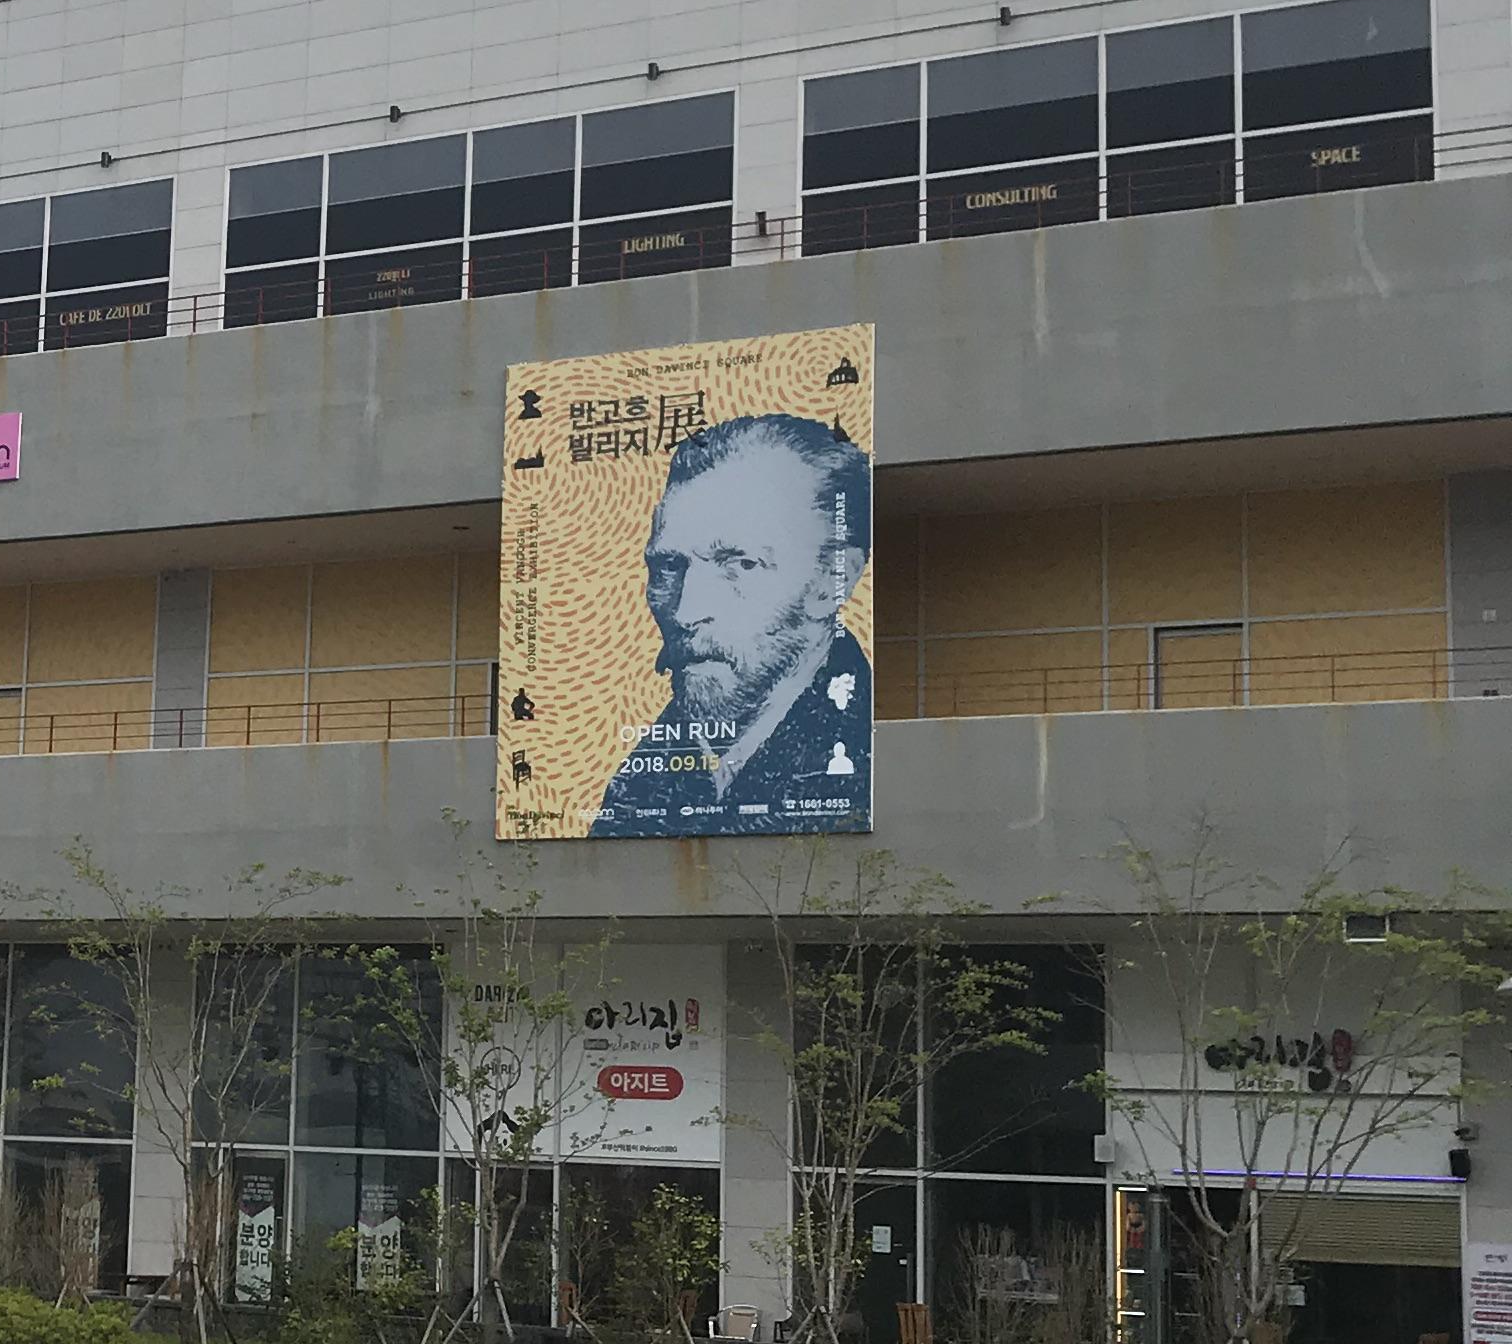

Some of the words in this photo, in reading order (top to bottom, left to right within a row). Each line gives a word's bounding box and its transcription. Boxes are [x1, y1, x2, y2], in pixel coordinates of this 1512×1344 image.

[1311, 146, 1361, 168] SPACE
[966, 184, 1057, 209] CONSULTING
[624, 233, 685, 254] LIGHTING
[368, 287, 414, 300] LIGHTNG
[59, 311, 86, 327] CAFE
[88, 309, 103, 322] DE
[657, 360, 709, 374] DAVINCI
[717, 354, 763, 368] SQUARE
[570, 395, 650, 430] 반고흐
[654, 390, 708, 453] 展
[569, 427, 650, 464] 빌리지
[835, 491, 847, 540] SQUARE
[835, 549, 846, 605] DAVINCI
[621, 723, 680, 743] OPEN
[689, 720, 737, 740] RUN
[619, 755, 719, 775] 2018.09.15
[475, 984, 528, 1003] DARIZ
[611, 1072, 670, 1093] 아지트
[240, 1223, 273, 1248] 분양
[361, 1231, 398, 1259] 분양
